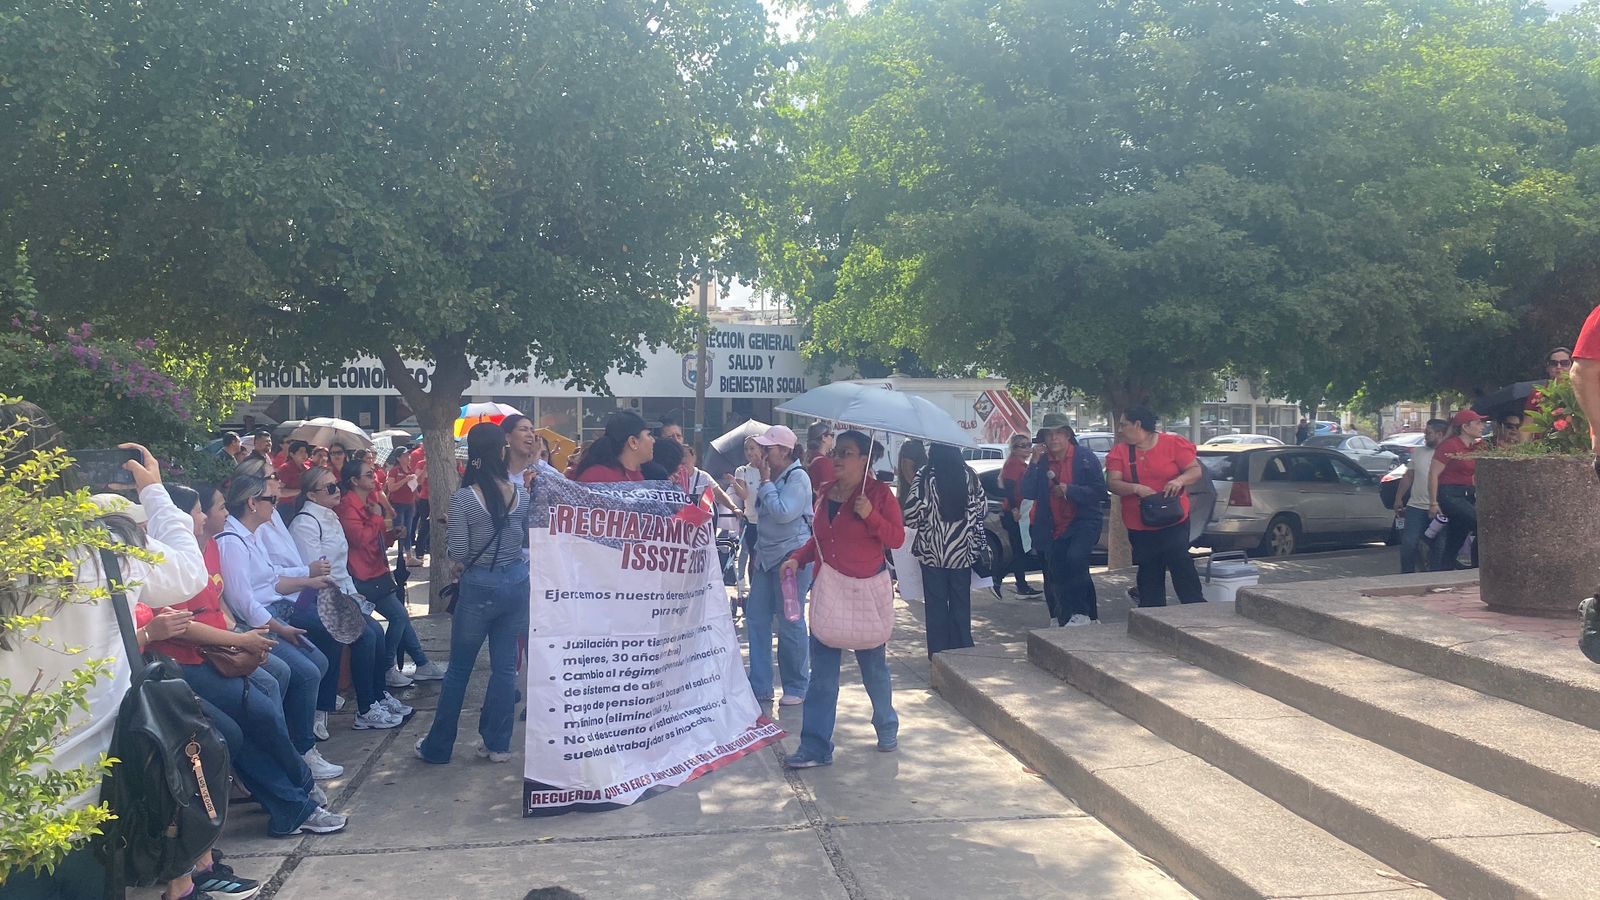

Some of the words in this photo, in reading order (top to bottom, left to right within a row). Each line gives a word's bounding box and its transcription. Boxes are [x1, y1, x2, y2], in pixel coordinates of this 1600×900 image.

[748, 333, 796, 351] GENERAL
[728, 354, 763, 370] SALUD
[768, 355, 776, 370] Y
[720, 376, 774, 393] BIENESTAR
[776, 378, 808, 393] SOCIAL
[621, 543, 688, 573] ISSSTE
[545, 590, 611, 602] Ejercemos
[615, 590, 665, 601] nuestro
[562, 637, 618, 650] Jubilación
[621, 640, 645, 649] por
[563, 655, 608, 669] mujeres,
[612, 653, 629, 662] 30
[631, 650, 660, 662] años
[562, 667, 604, 681] Cambio
[605, 668, 617, 679] al
[564, 687, 582, 697] de
[583, 684, 621, 696] sistema
[623, 682, 640, 691] de
[564, 702, 592, 714] Pago
[592, 699, 605, 710] de
[693, 674, 721, 688] salario
[564, 717, 604, 729] mínimo
[564, 735, 586, 745] No
[595, 726, 646, 740] descuento
[563, 748, 603, 761] sueldo
[664, 731, 676, 740] es
[532, 789, 601, 805] RECUERDA
[604, 784, 623, 800] QUE
[620, 781, 631, 793] SI
[629, 774, 652, 791] ERES
